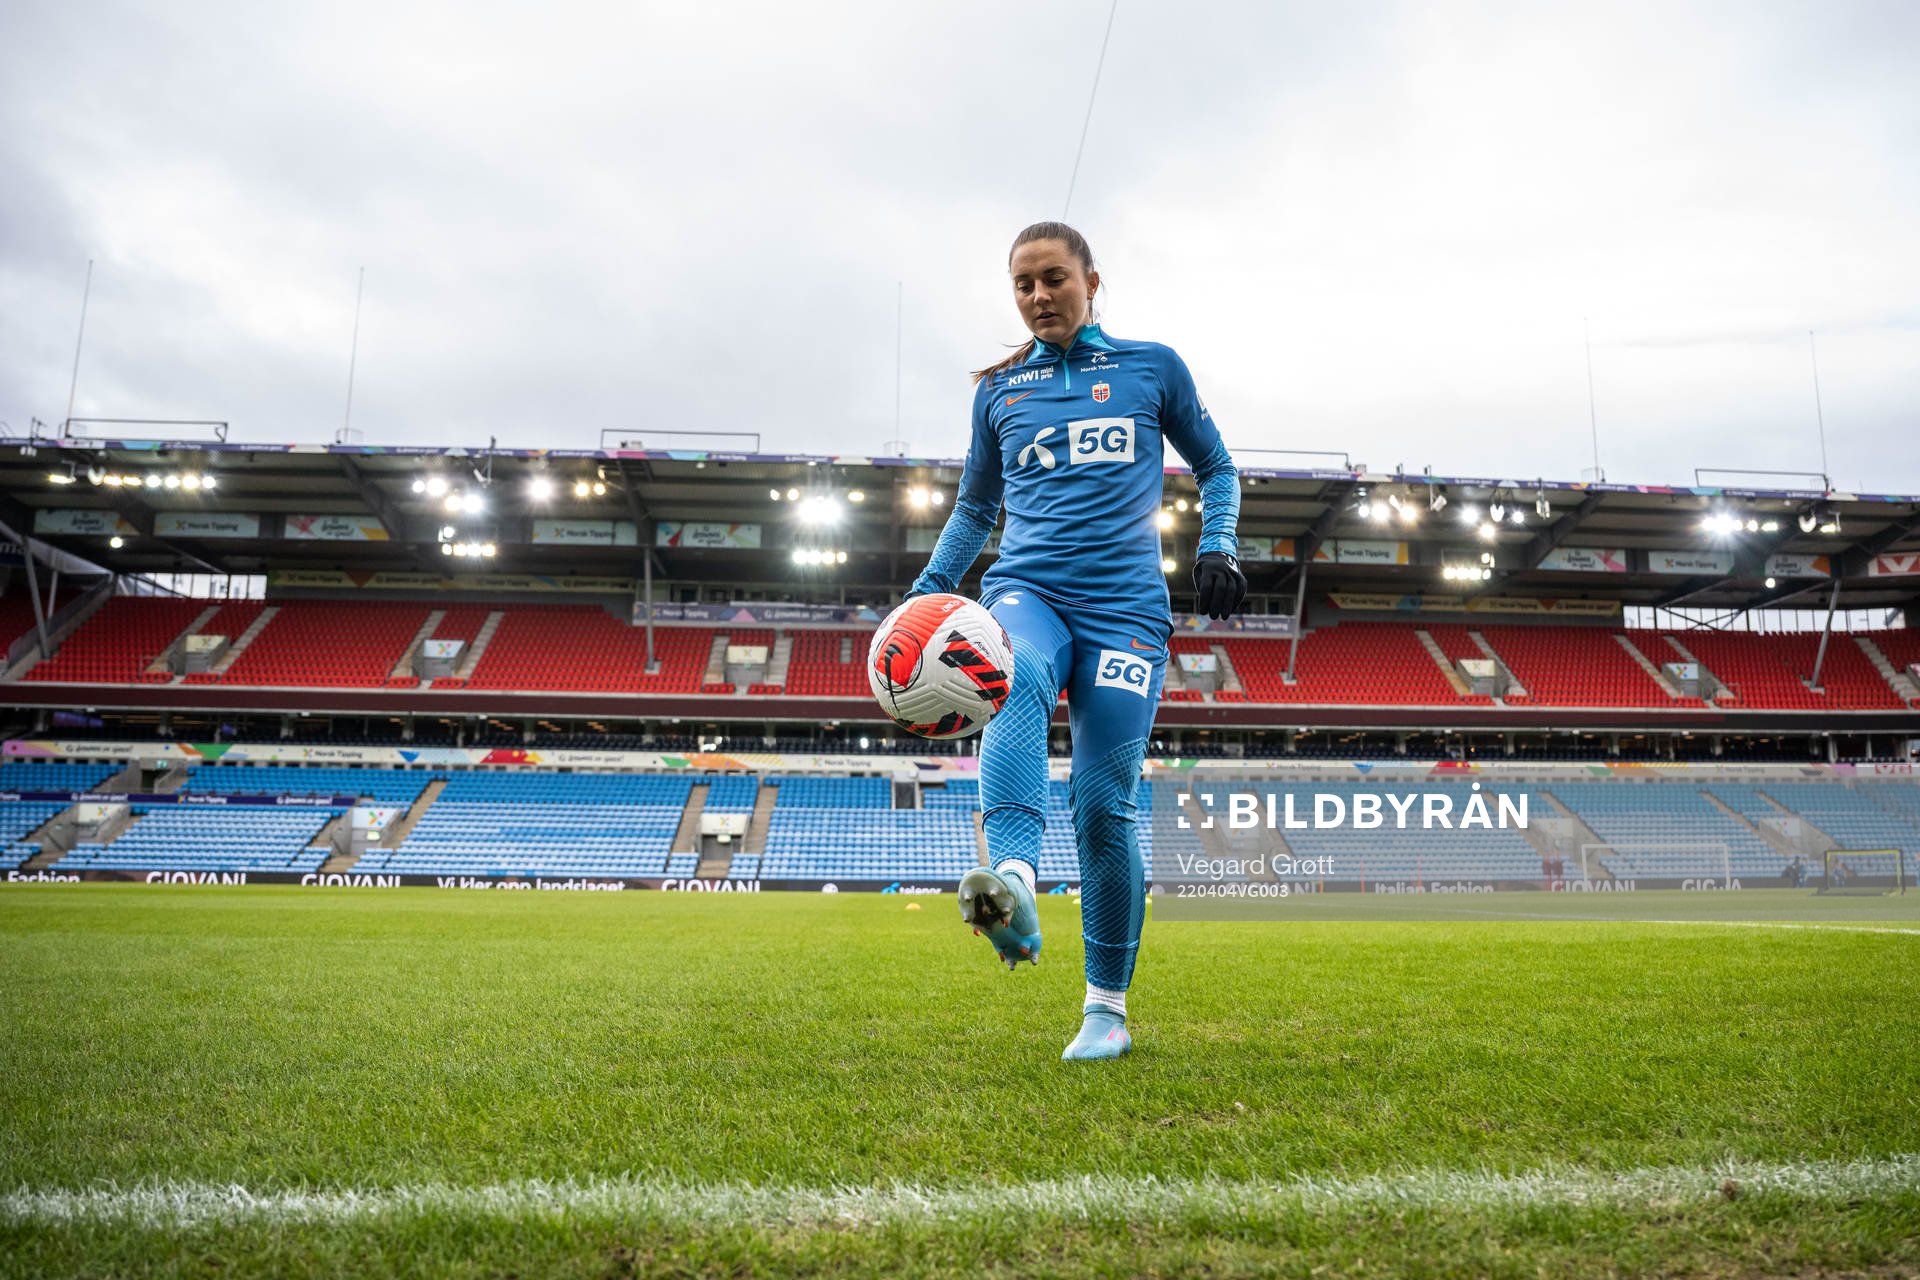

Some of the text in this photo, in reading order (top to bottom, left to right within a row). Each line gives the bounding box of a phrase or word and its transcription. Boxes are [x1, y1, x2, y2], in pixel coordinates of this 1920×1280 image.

[1040, 365, 1054, 374] mini
[1080, 363, 1119, 373] Norsk Tipping
[1008, 370, 1039, 386] KIWI
[1040, 373, 1053, 381] pris
[1077, 425, 1128, 455] 5G
[1102, 657, 1147, 687] 5G
